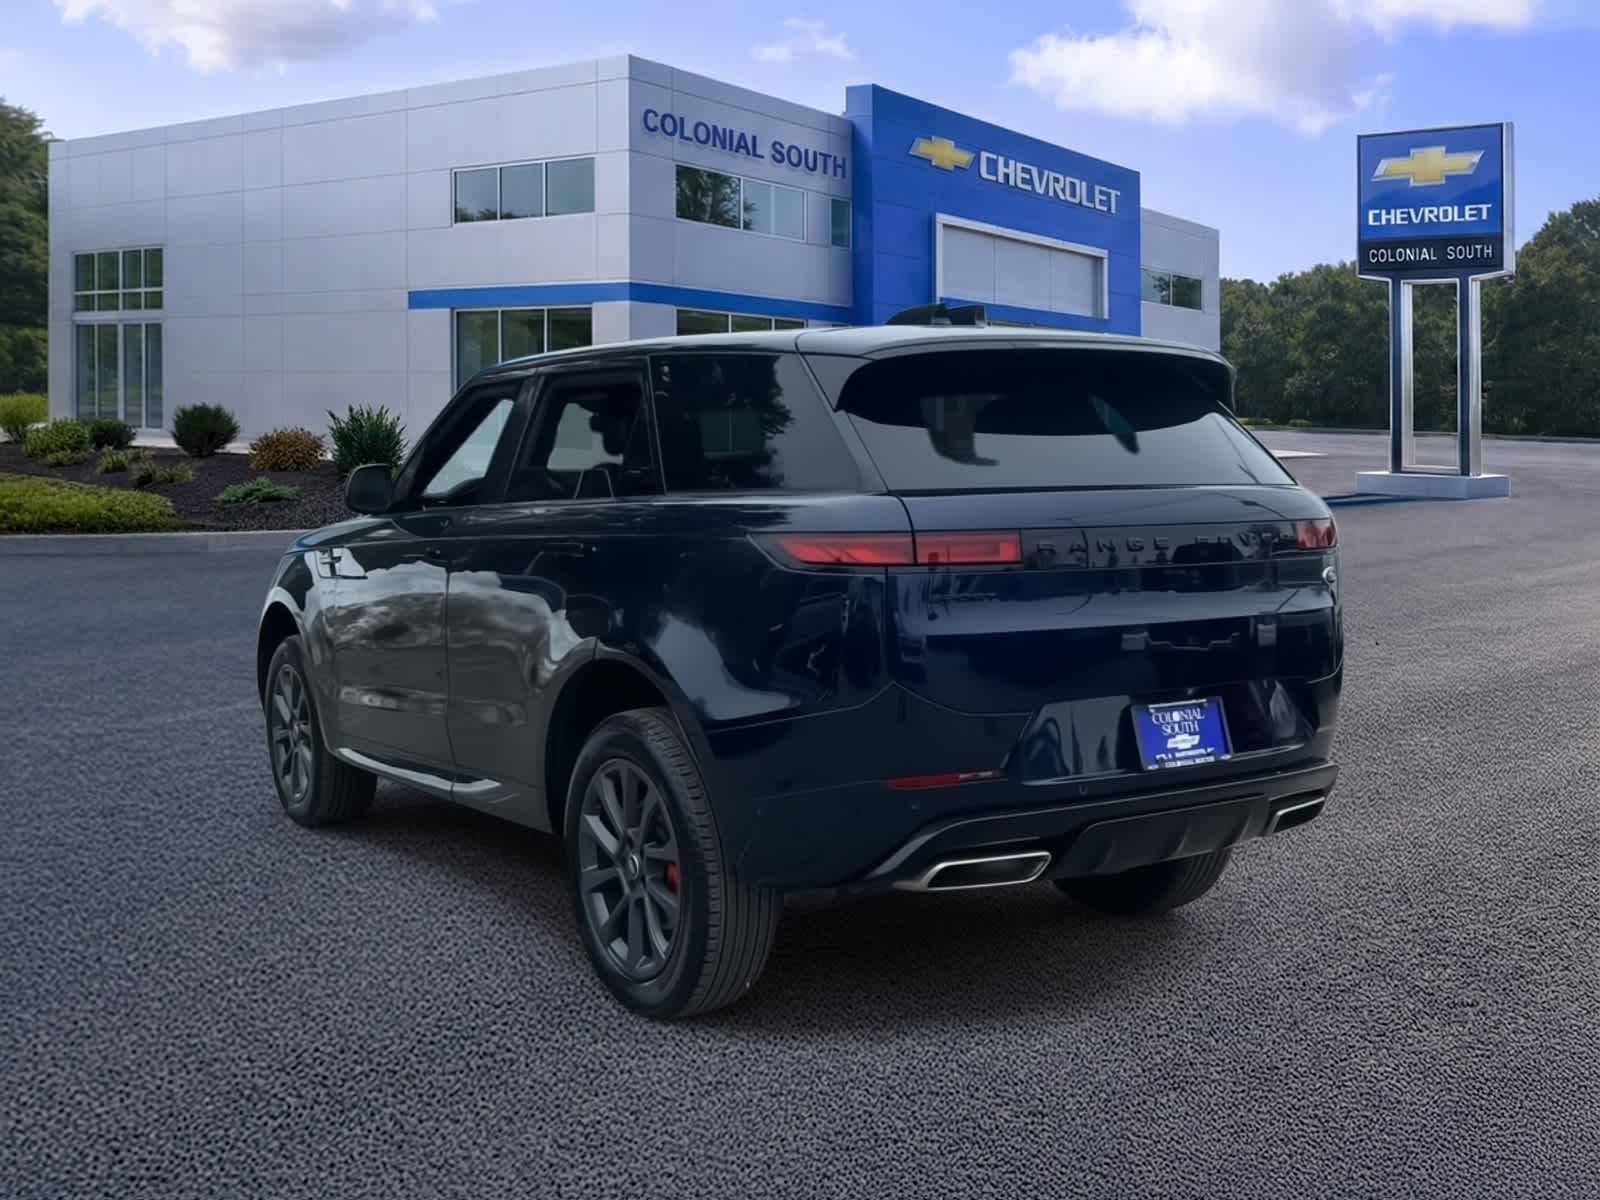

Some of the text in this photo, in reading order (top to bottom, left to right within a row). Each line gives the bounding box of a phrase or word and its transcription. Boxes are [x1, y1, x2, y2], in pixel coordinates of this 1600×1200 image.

[642, 108, 847, 179] COLONIAL SOUTH
[979, 150, 1121, 214] CHEVROLET
[1367, 203, 1492, 226] CHEVROLET
[1369, 244, 1493, 264] COLONIAL SOUTH
[1035, 535, 1169, 554] RANGE
[1151, 708, 1205, 725] COLONIAL
[1161, 720, 1200, 736] SOUTH
